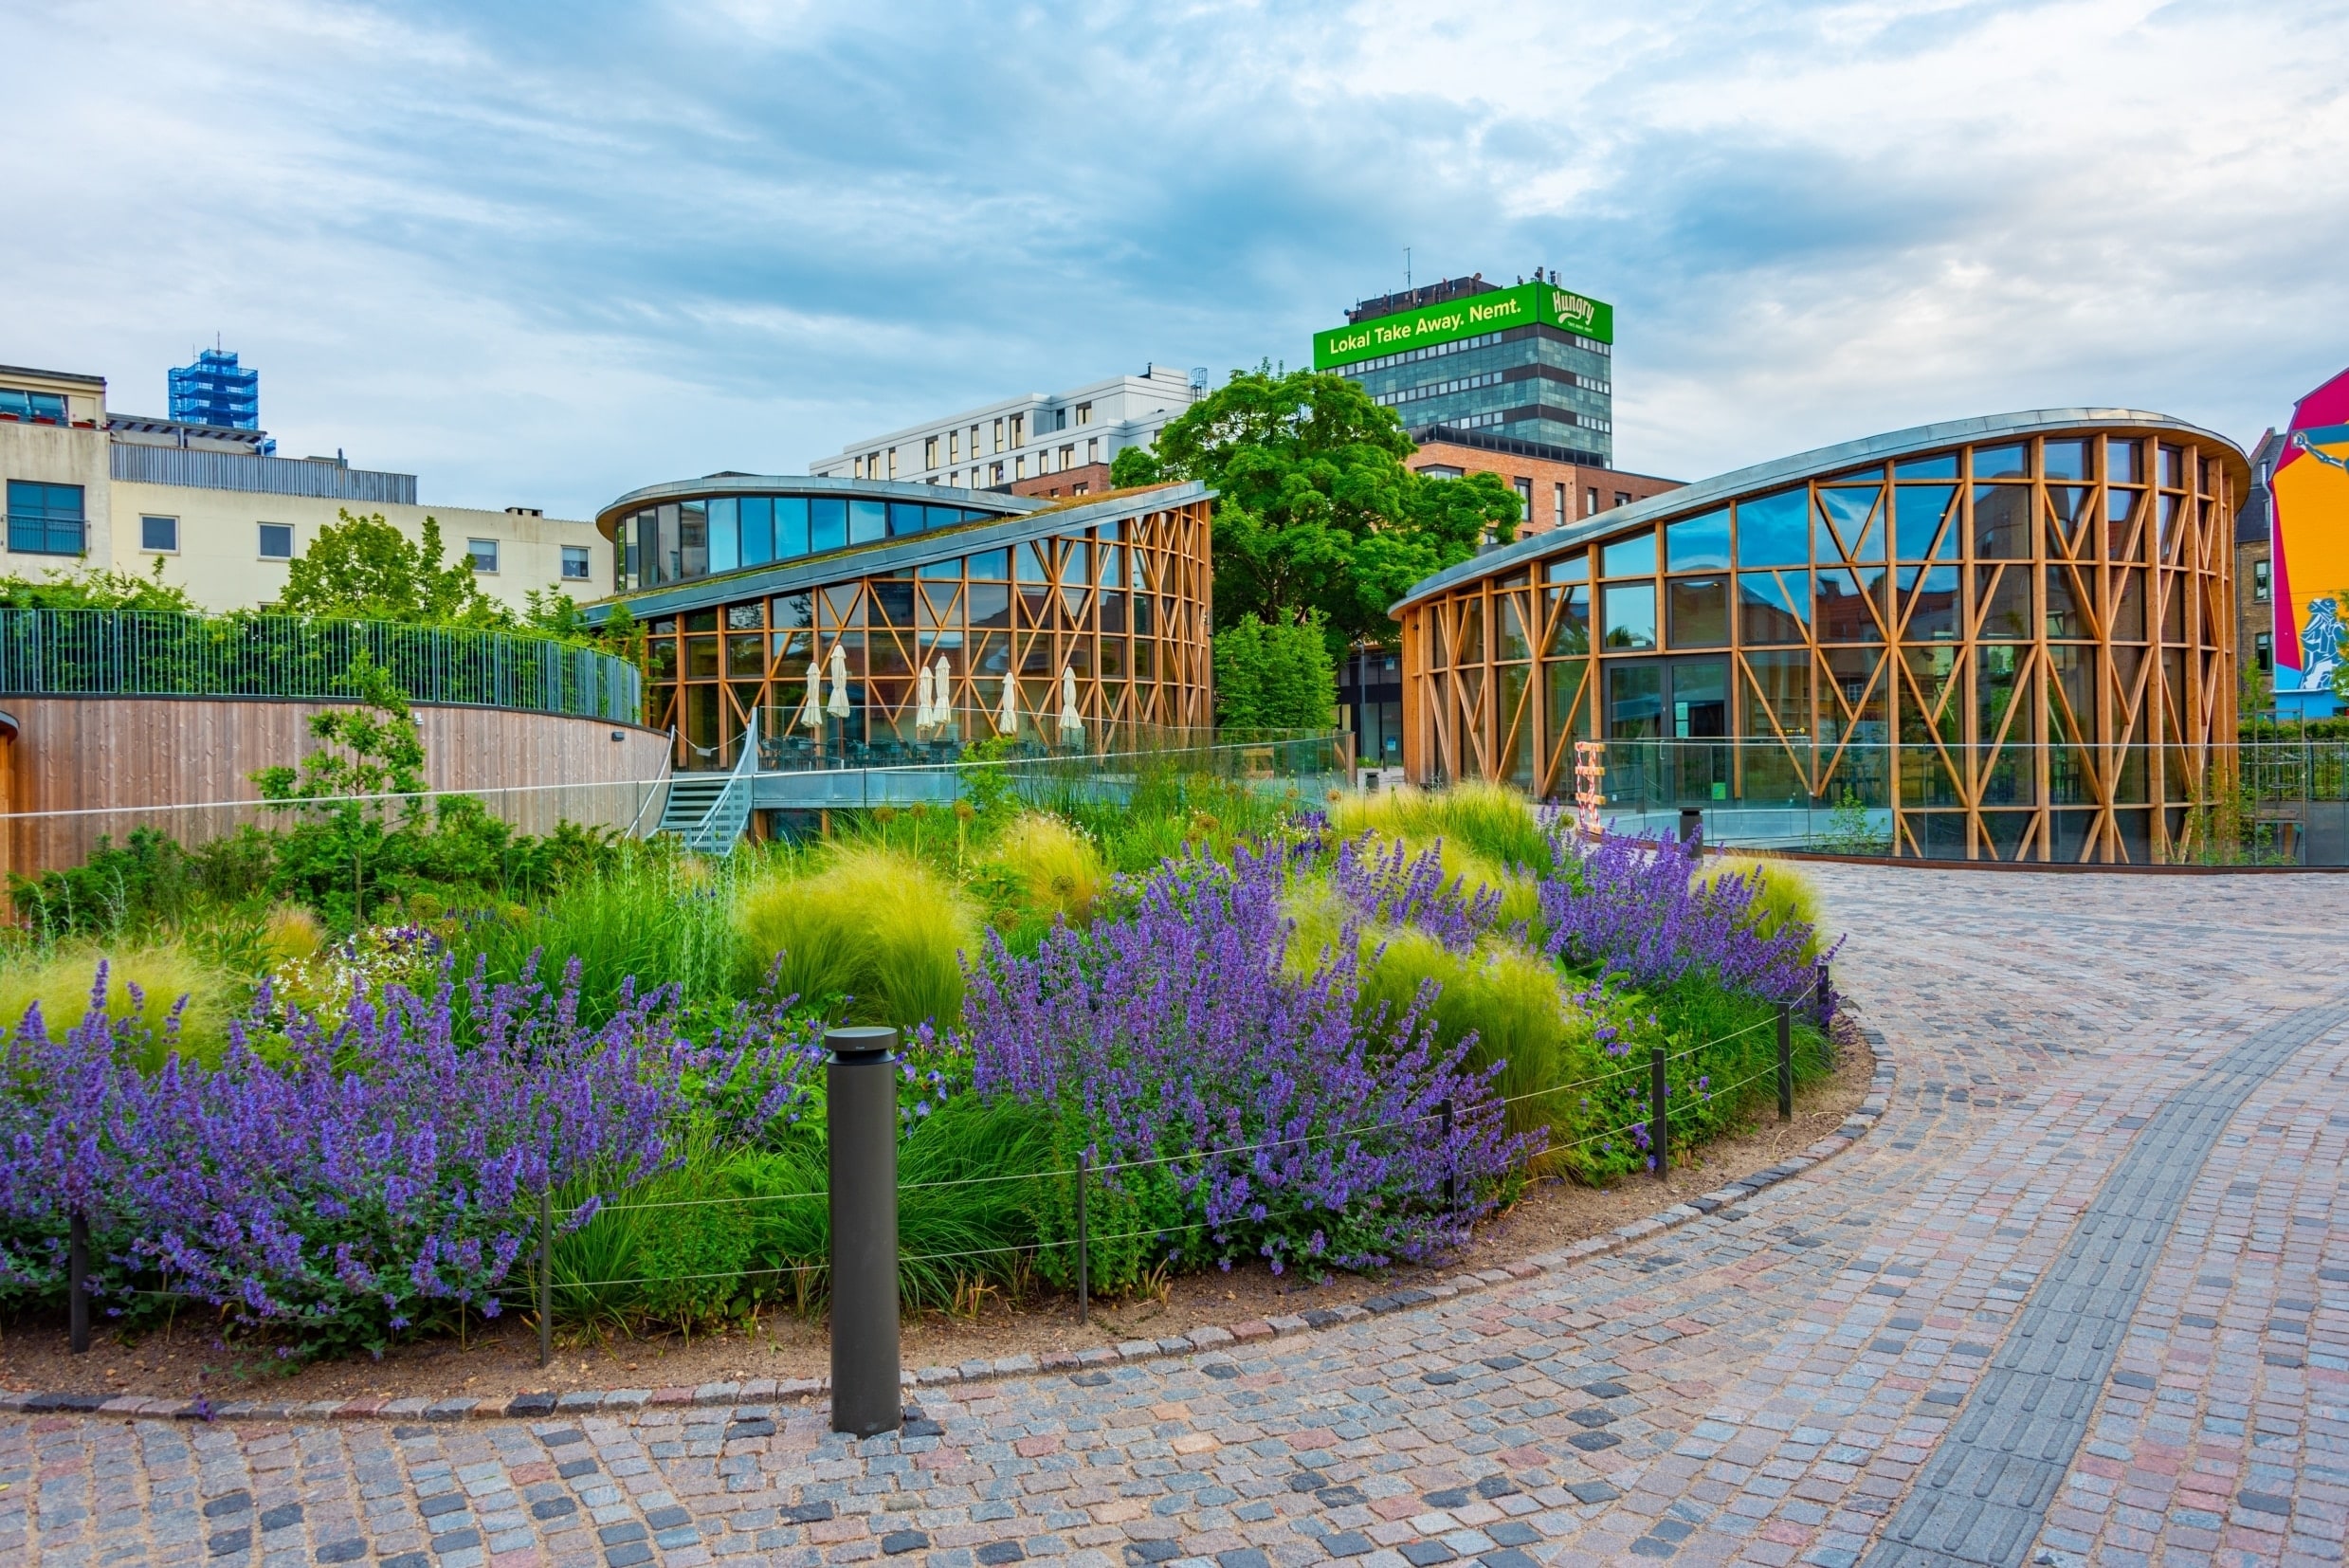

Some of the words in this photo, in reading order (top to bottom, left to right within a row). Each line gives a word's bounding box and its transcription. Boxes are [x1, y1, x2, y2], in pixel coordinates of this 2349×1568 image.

[1330, 331, 1371, 355] Lokal
[1375, 325, 1411, 344] Take
[1415, 314, 1465, 336] Away.
[1469, 299, 1521, 323] Nemt.
[1552, 290, 1594, 326] Hungry
